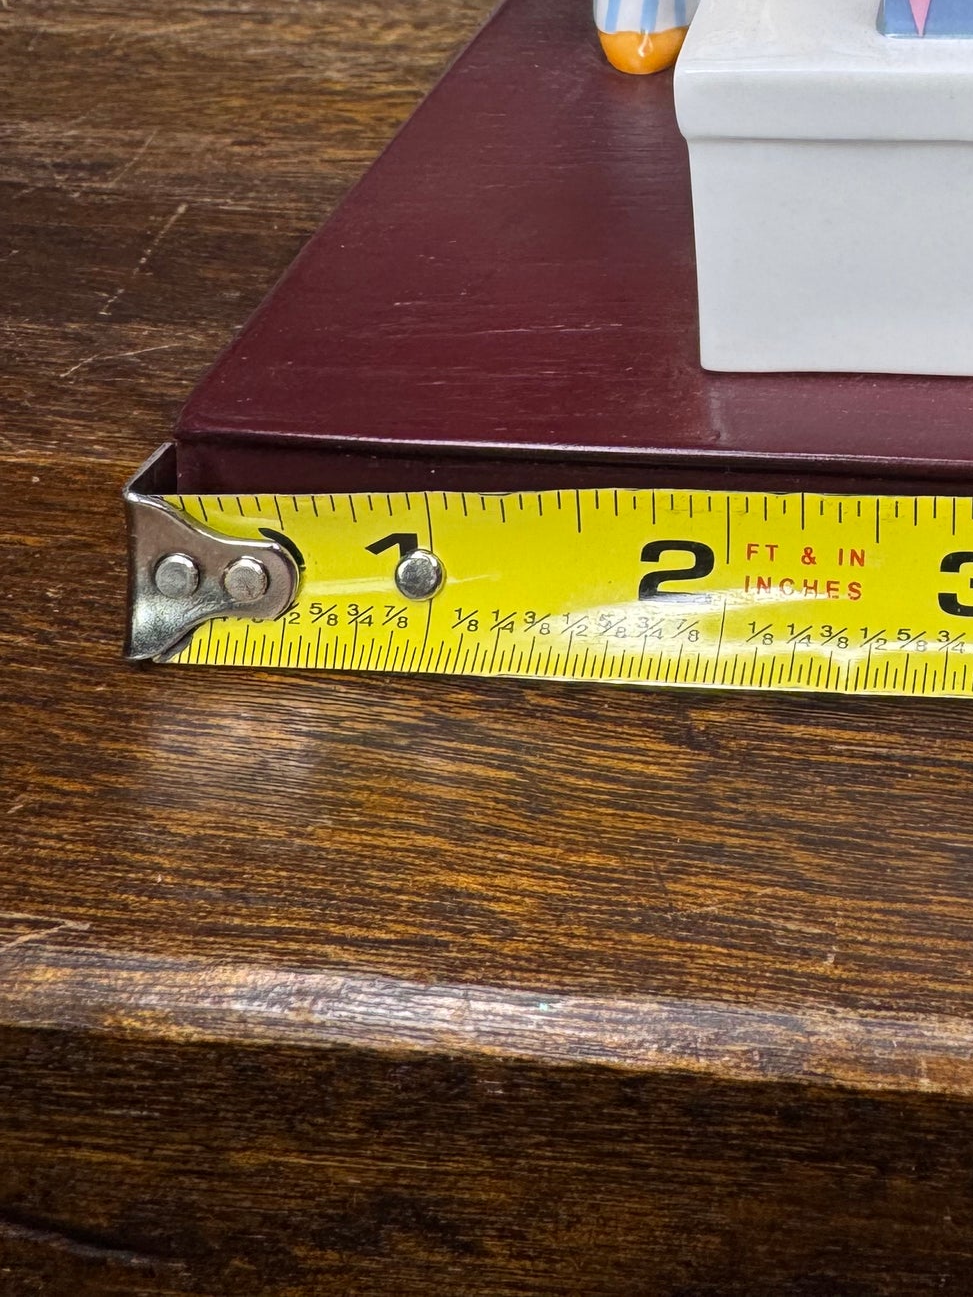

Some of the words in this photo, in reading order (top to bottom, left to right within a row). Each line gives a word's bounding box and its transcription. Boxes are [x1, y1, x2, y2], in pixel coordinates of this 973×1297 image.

[746, 543, 779, 562] FT
[801, 546, 817, 565] &
[838, 548, 865, 567] IN
[639, 539, 715, 601] 2
[744, 575, 862, 601] INCHES
